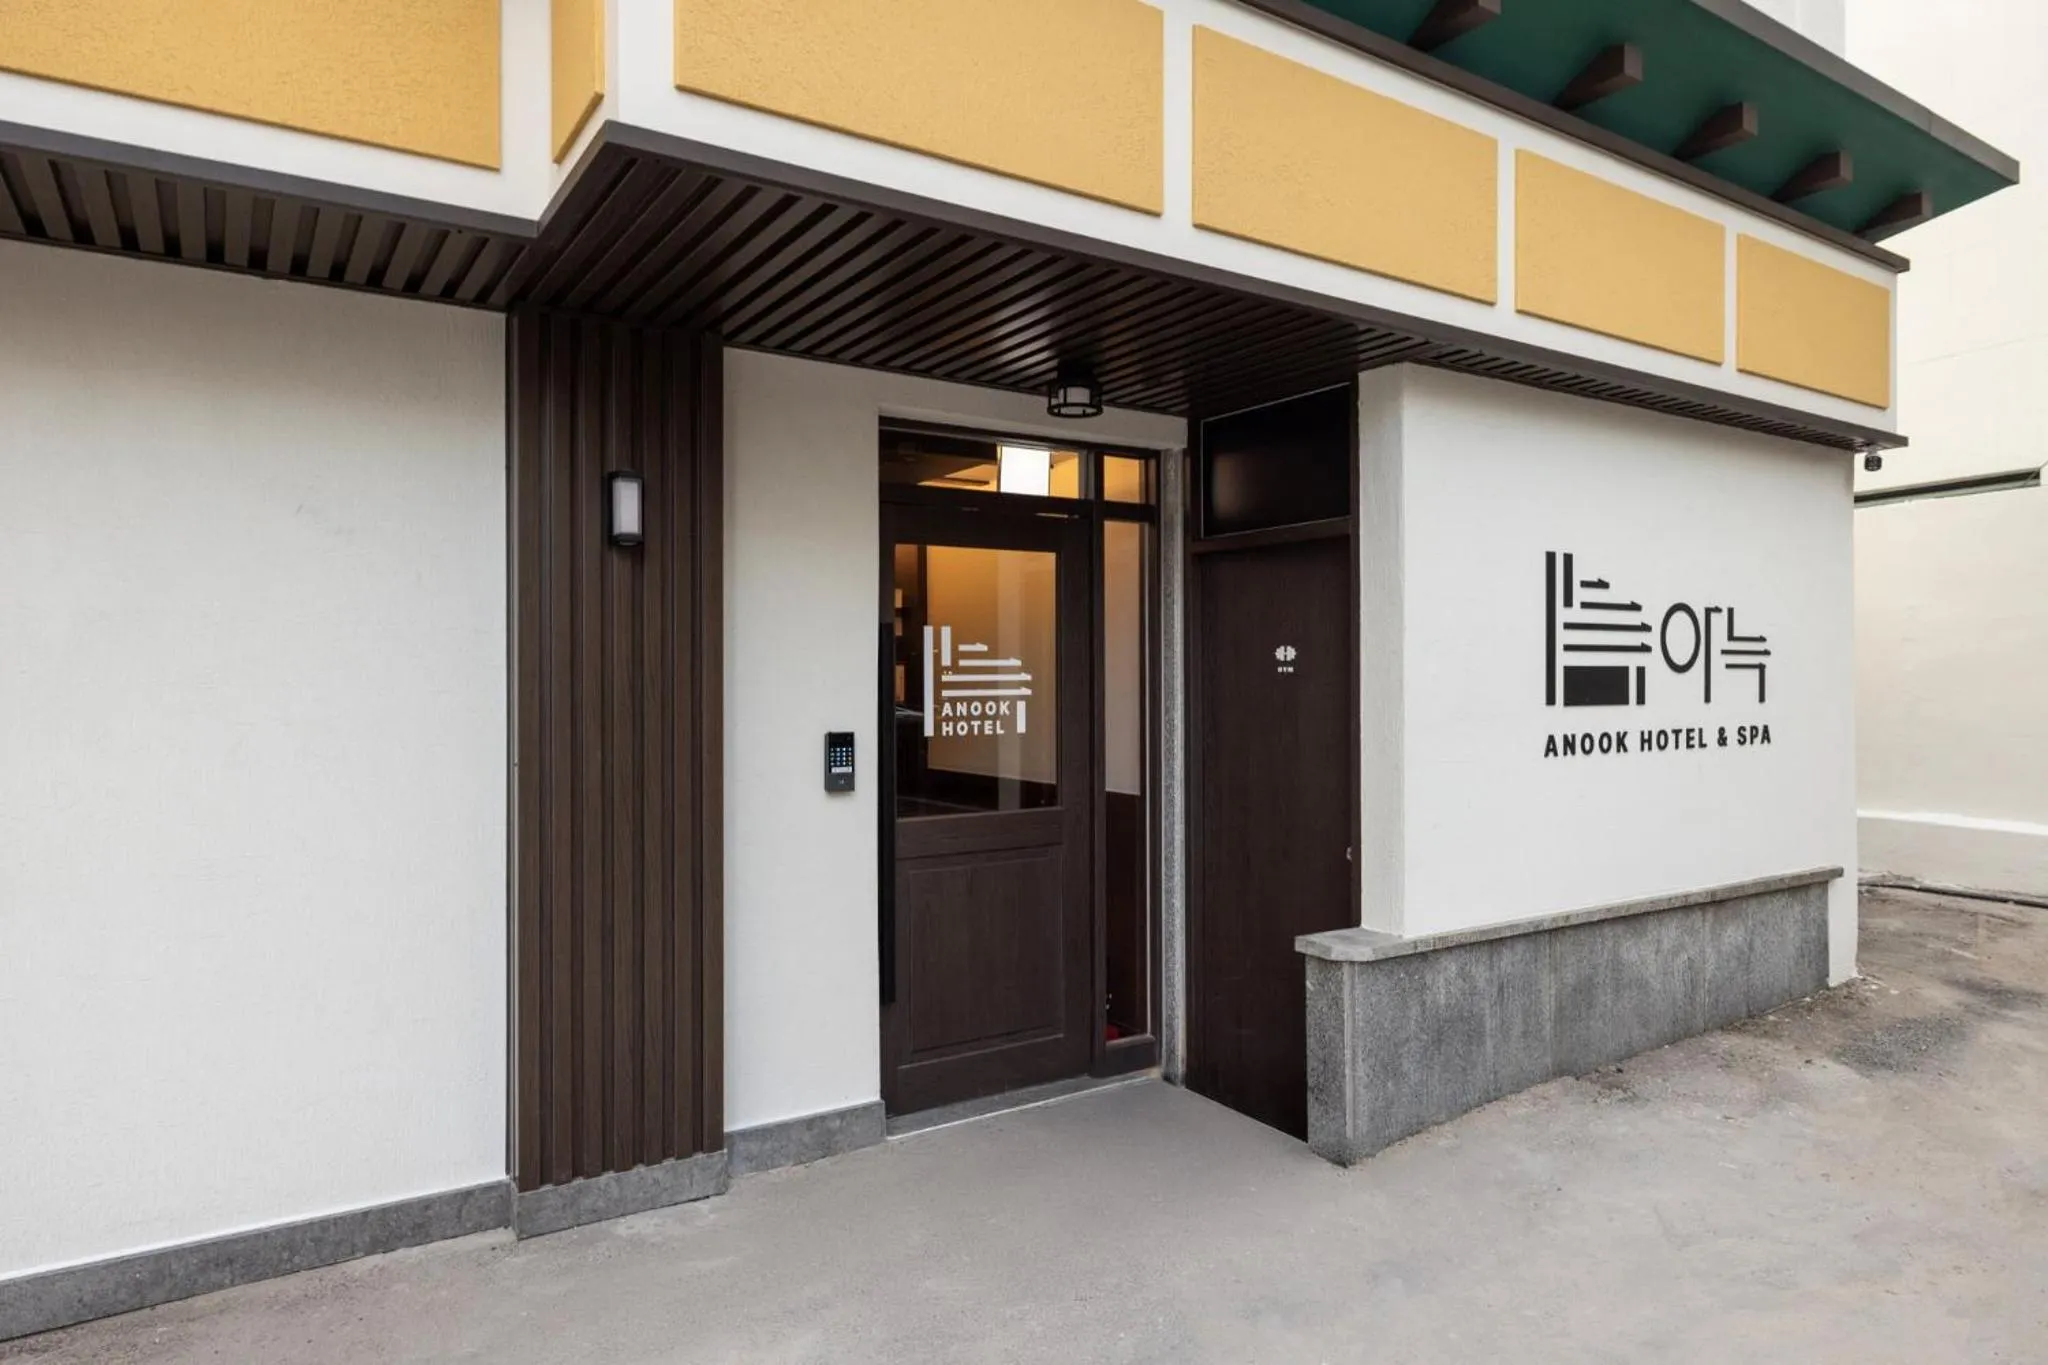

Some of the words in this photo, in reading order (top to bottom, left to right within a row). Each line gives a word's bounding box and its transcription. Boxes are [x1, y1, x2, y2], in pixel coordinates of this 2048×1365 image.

[941, 700, 1011, 717] ANOOK
[941, 720, 1005, 737] HOTEL
[1543, 731, 1629, 758] ANOOK
[1640, 727, 1708, 752] HOTEL
[1717, 726, 1728, 747] &
[1737, 724, 1772, 746] SPA
